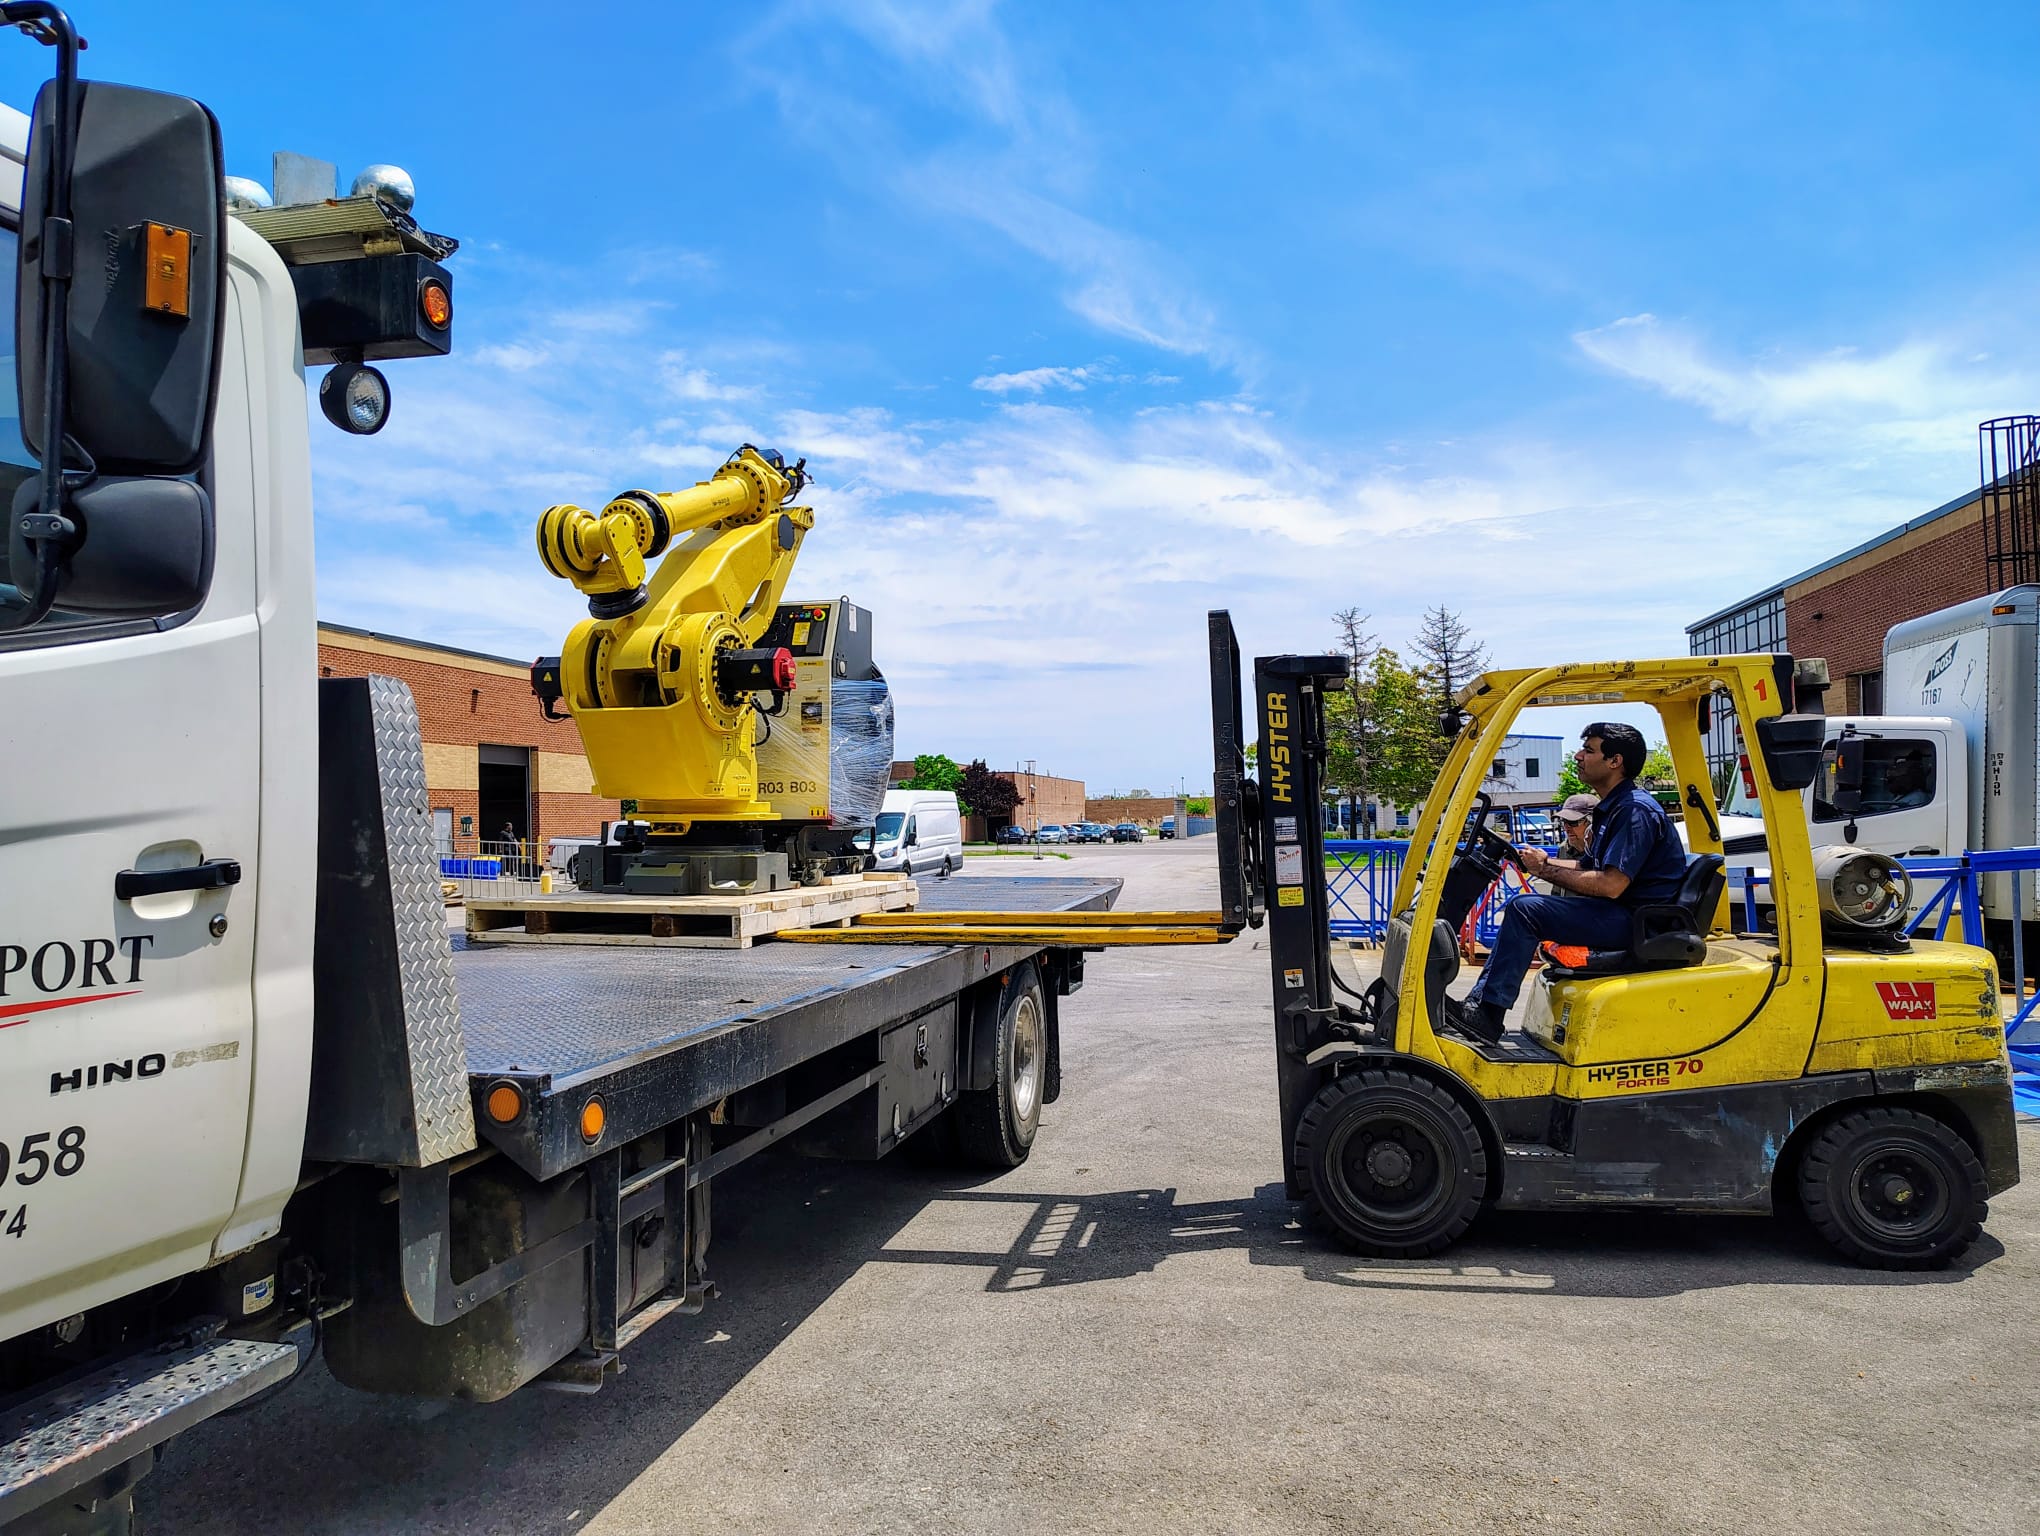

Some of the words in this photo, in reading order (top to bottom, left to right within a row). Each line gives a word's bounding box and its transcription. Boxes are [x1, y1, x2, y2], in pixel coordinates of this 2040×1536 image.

[1753, 679, 1768, 701] 1
[1921, 688, 1942, 706] 17167
[1267, 692, 1292, 803] HYSTER
[790, 781, 817, 793] B03
[0, 935, 154, 997] PORT
[1887, 1000, 1932, 1013] WAJAX
[50, 1053, 166, 1094] HINO
[1588, 1062, 1669, 1083] HYSTER
[1674, 1059, 1704, 1075] 70
[1616, 1077, 1670, 1089] FORTIS
